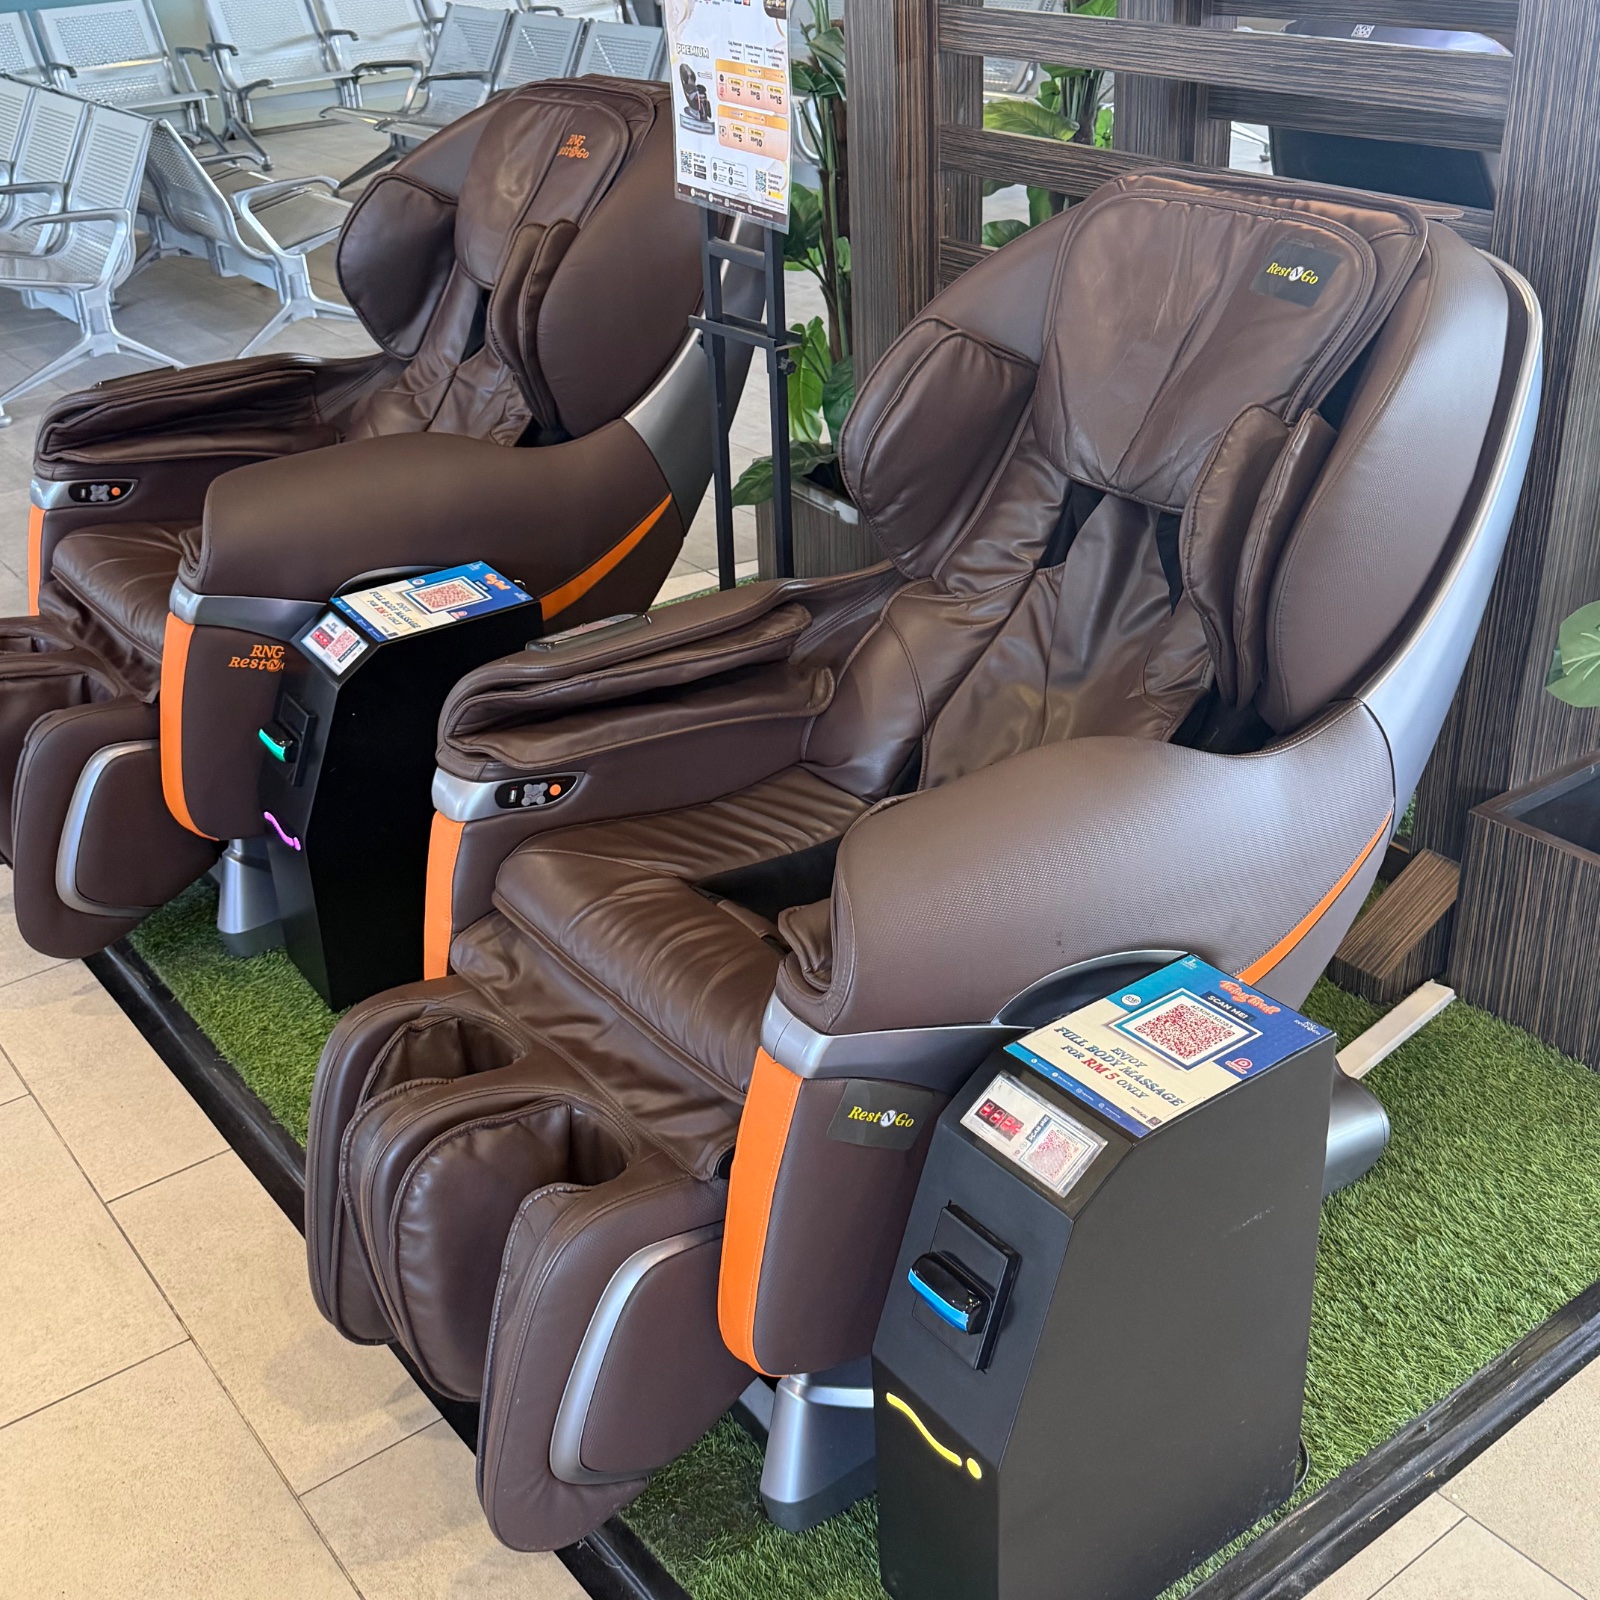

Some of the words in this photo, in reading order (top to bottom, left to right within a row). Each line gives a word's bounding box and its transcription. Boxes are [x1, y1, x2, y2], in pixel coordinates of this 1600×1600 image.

[676, 43, 709, 59] PREMIUM
[249, 644, 285, 659] RNG
[1207, 994, 1233, 1011] SCAN
[1230, 1007, 1249, 1019] ME!
[1053, 1026, 1086, 1047] FULL
[1085, 1044, 1126, 1067] BODY
[1119, 1063, 1185, 1107] MASSAGE
[1110, 1047, 1148, 1069] ENJOY
[1061, 1045, 1086, 1060] FOR
[1081, 1057, 1112, 1074] RM
[1104, 1072, 1120, 1081] 5
[1116, 1079, 1149, 1099] ONLY
